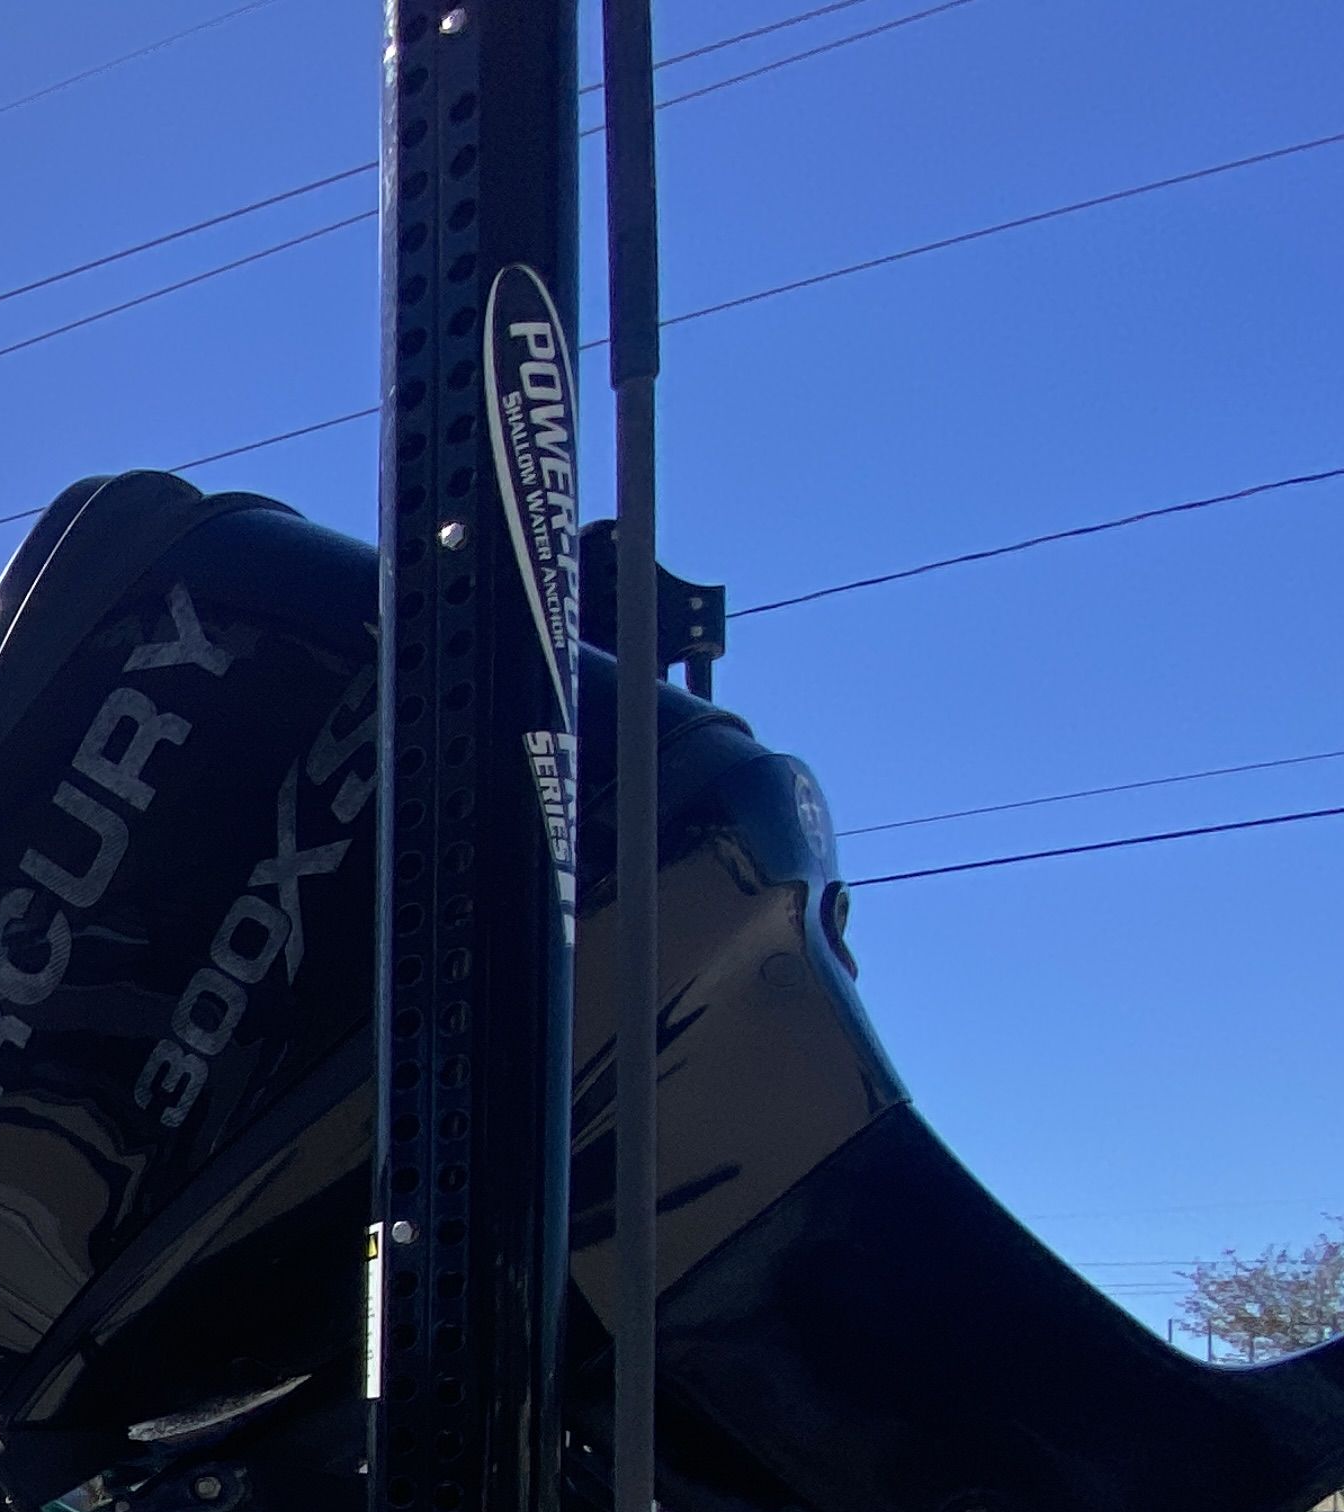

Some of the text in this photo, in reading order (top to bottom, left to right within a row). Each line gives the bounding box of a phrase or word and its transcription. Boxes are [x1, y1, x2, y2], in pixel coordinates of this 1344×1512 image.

[502, 390, 565, 649] SHALLOW WATER ANCHOR
[525, 730, 571, 862] SERIES
